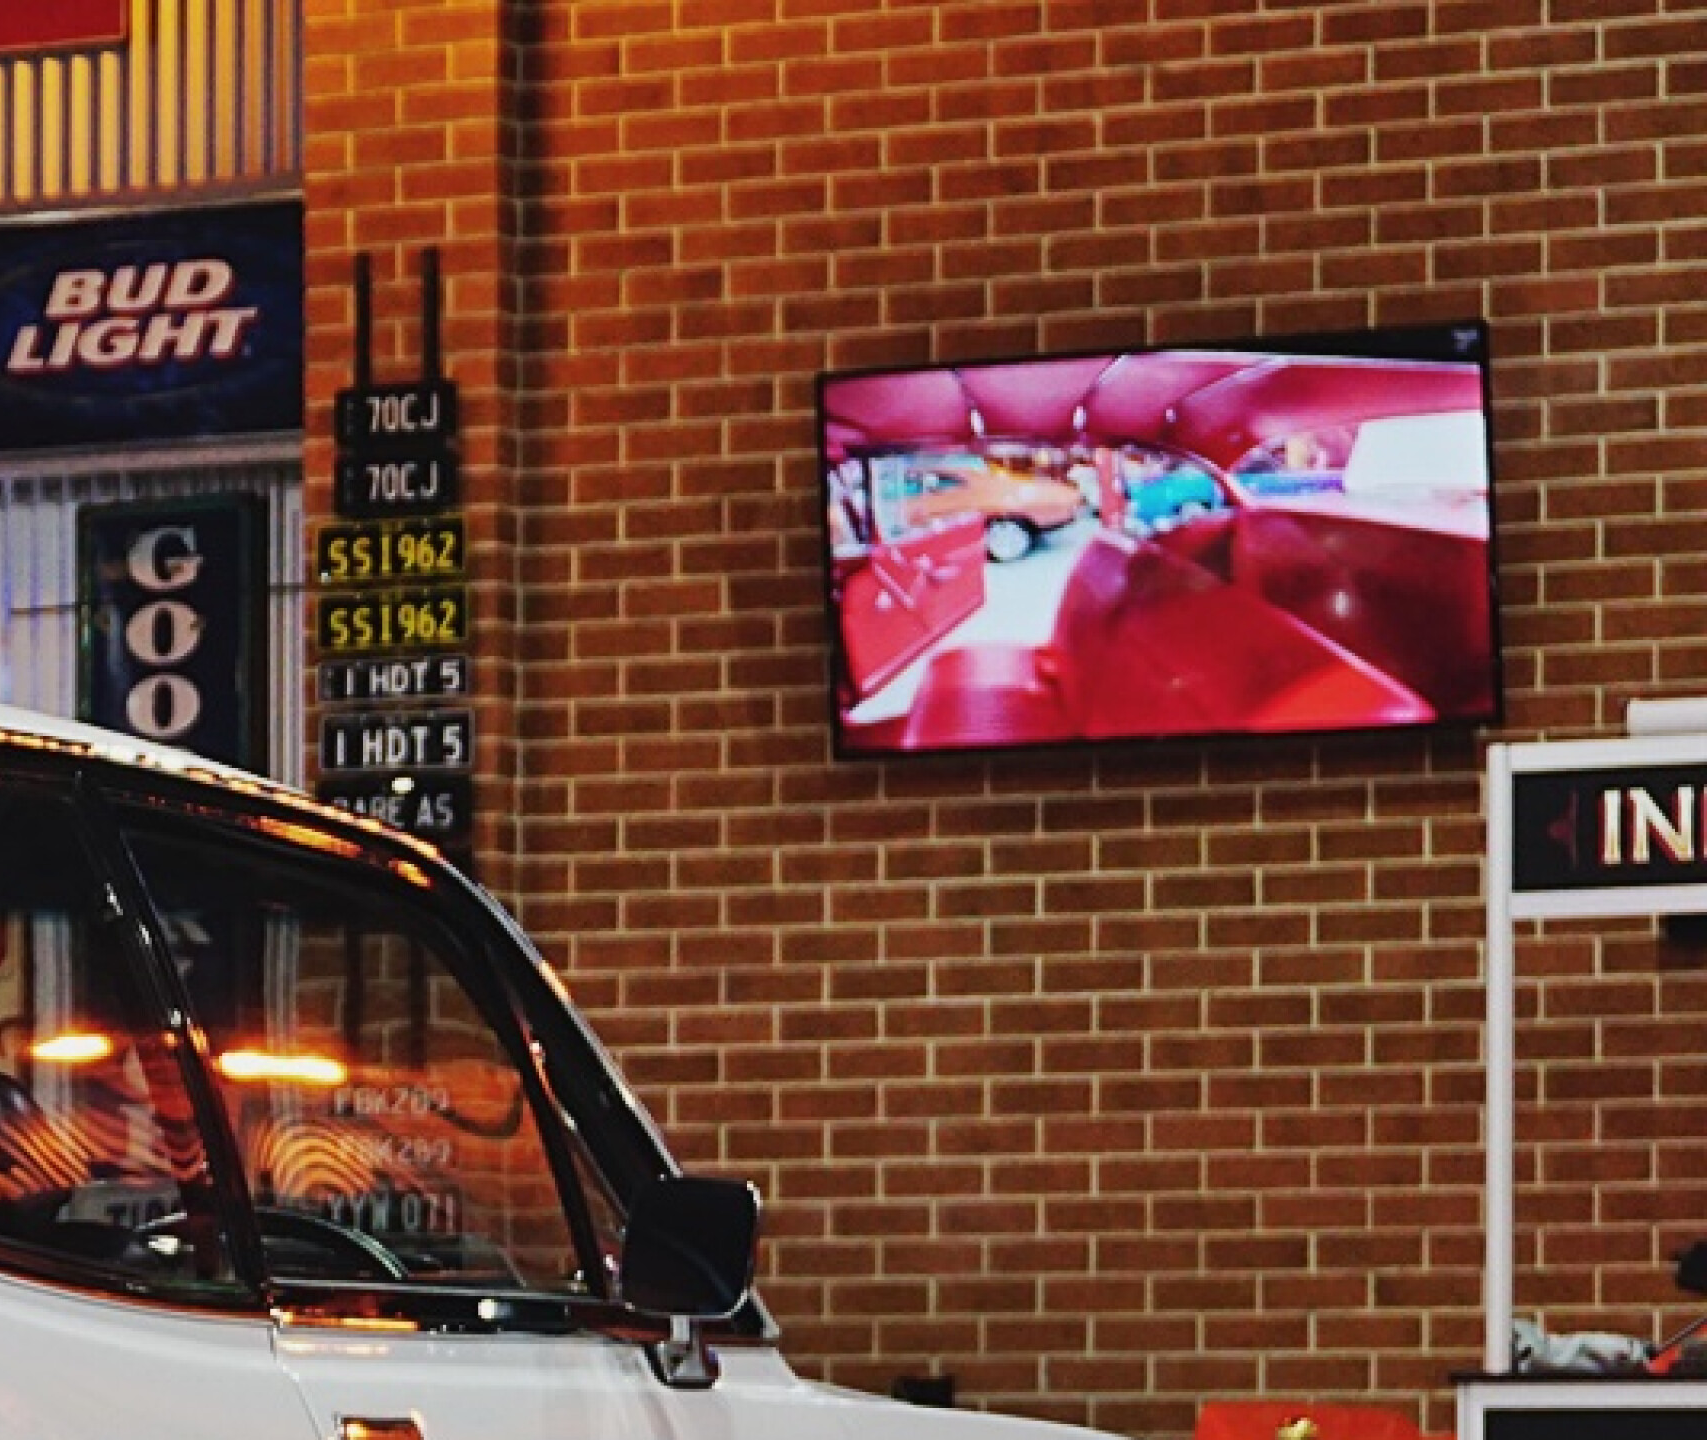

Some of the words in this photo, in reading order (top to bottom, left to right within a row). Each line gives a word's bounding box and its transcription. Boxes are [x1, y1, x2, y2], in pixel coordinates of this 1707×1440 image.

[44, 258, 235, 319] BUD
[5, 304, 259, 374] LIGHT
[366, 394, 440, 432] 70CJ
[366, 461, 439, 500] 70CJ
[369, 660, 428, 693] HDT
[439, 658, 460, 689] 5
[362, 725, 428, 764] HDT
[442, 724, 463, 762] 5
[1598, 783, 1707, 868] IN
